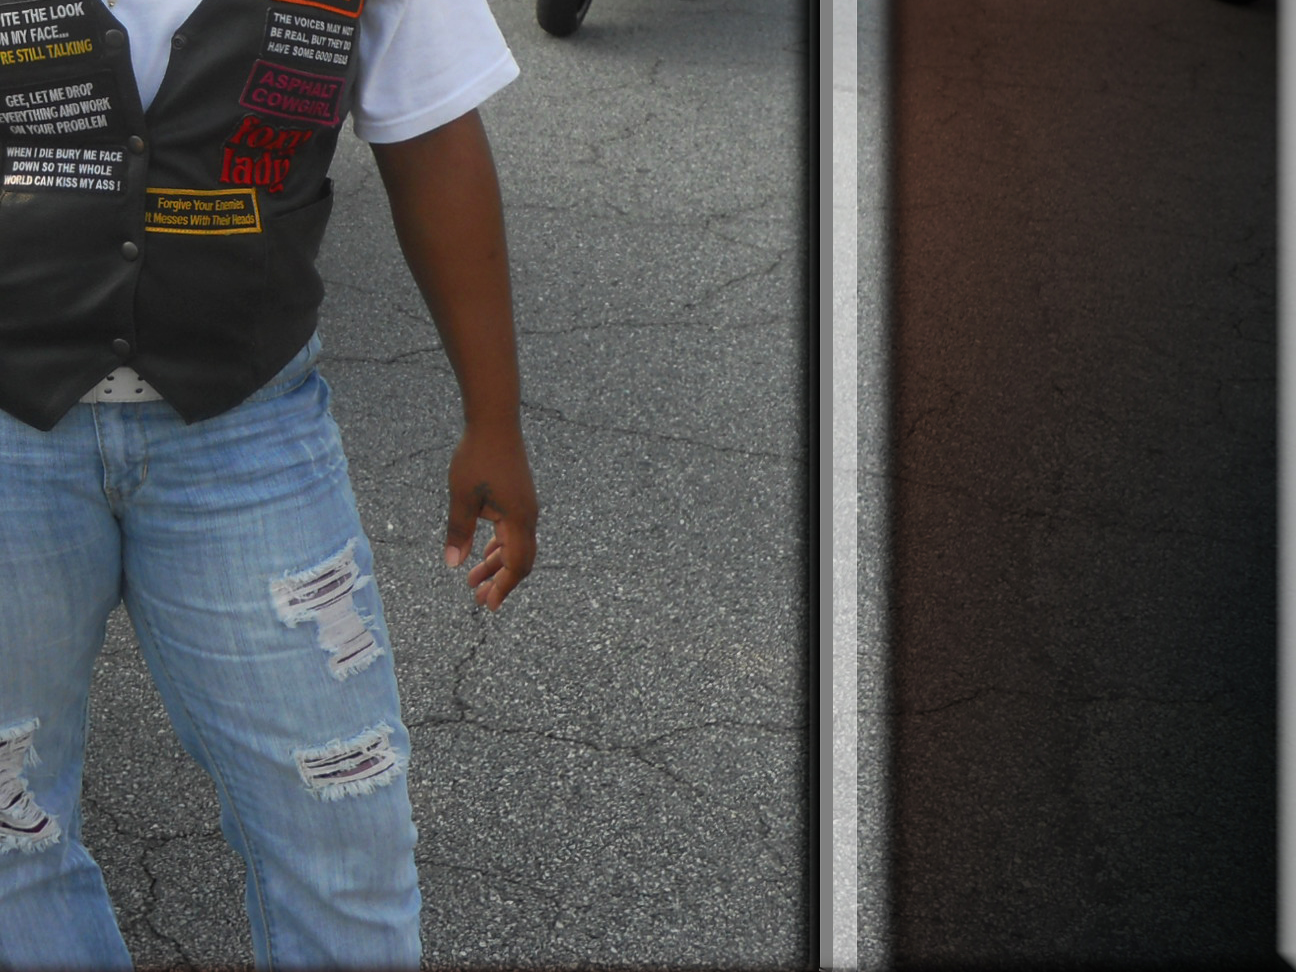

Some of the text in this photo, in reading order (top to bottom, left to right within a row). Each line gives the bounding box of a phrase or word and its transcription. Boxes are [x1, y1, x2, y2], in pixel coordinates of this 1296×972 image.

[22, 7, 47, 25] THE
[50, 1, 85, 20] LOOK
[273, 12, 293, 25] THE
[294, 16, 325, 31] VOICES
[326, 23, 341, 34] MAY
[11, 28, 27, 44] MY
[270, 26, 284, 38] BE
[284, 29, 310, 45] REAL,
[311, 34, 327, 46] BUT
[327, 38, 343, 49] THEY
[17, 46, 46, 63] STILL
[46, 38, 93, 58] TALKING
[267, 41, 291, 55] HAVE
[292, 46, 315, 59] SOME
[315, 50, 333, 63] GOOD
[5, 82, 93, 108] GEE, LET ME DROP
[260, 70, 337, 99] ASPHALT
[60, 102, 80, 117] AND
[80, 97, 112, 114] WORK
[252, 88, 331, 117] COWGIRL
[10, 114, 108, 135] ON YOUR PROBLEM
[6, 146, 32, 157] WHEN
[39, 148, 54, 158] DIE
[56, 149, 81, 160] BURY
[83, 150, 97, 160] ME
[99, 150, 123, 162] FACE
[13, 161, 113, 176] DOWN SO THE WHOLE
[219, 147, 290, 193] lady
[4, 175, 33, 186] WORLD
[34, 175, 54, 186] CAN
[56, 176, 78, 188] KISS
[80, 178, 94, 189] MY
[158, 197, 245, 212] Forgive Your Enemies
[153, 212, 189, 225] Messes
[190, 214, 211, 226] With
[212, 214, 231, 226] Their
[231, 213, 255, 225] Heads
